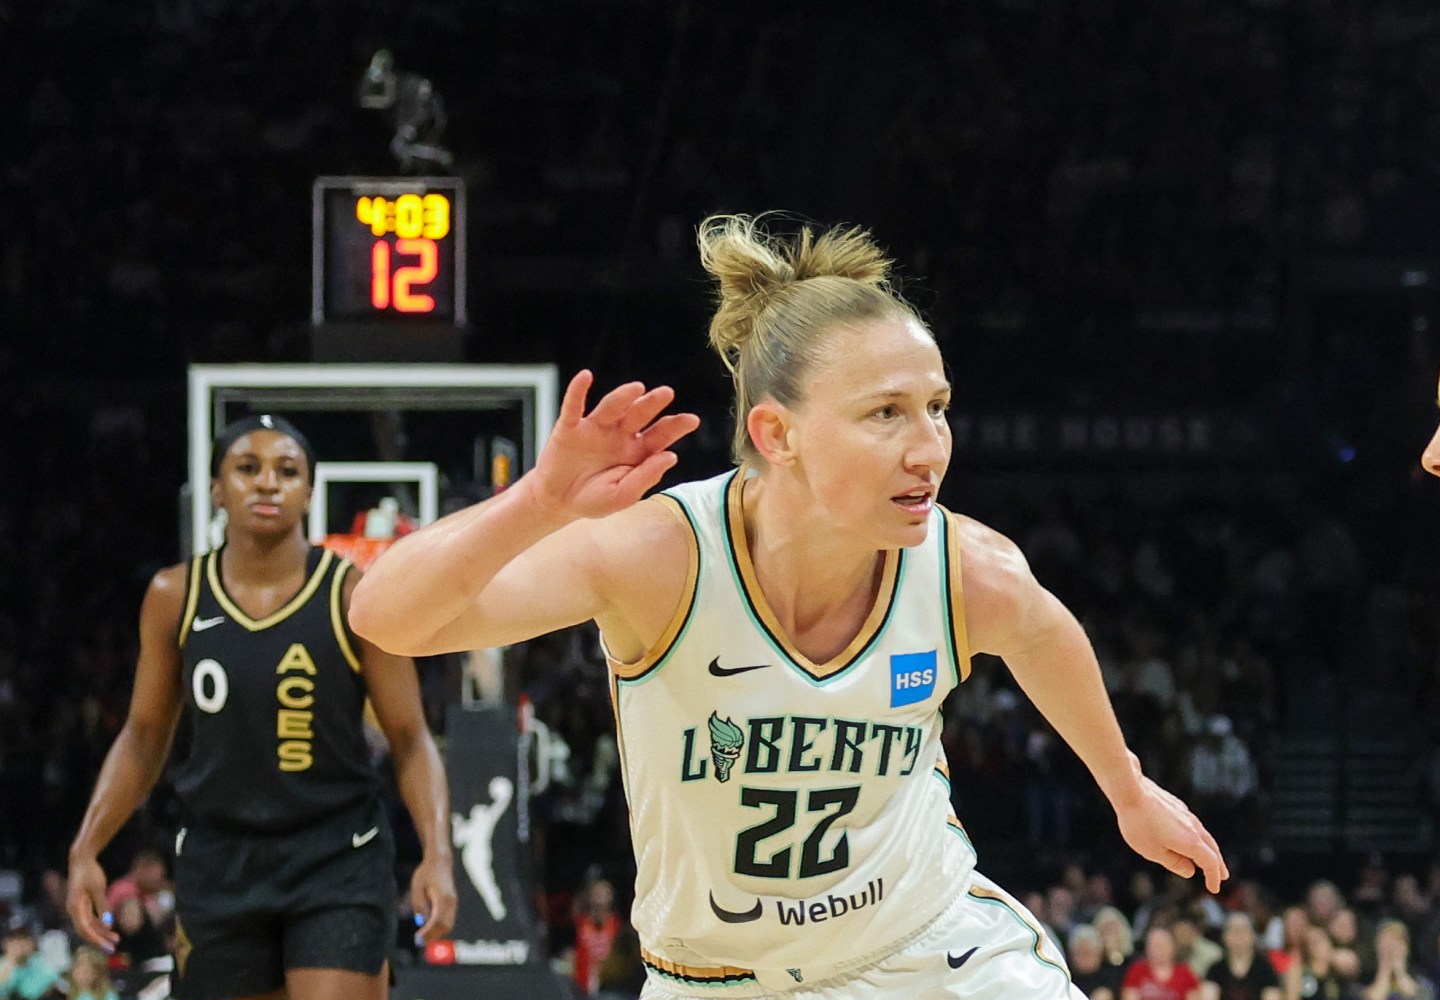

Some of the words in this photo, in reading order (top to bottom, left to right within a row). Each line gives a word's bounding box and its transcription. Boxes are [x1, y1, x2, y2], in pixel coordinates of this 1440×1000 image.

[356, 193, 451, 239] 4:03
[371, 239, 439, 312] 12
[192, 657, 229, 714] 0
[895, 668, 934, 690] HSS
[276, 643, 318, 773] ACES
[733, 784, 862, 880] 22
[776, 877, 884, 926] Webull
